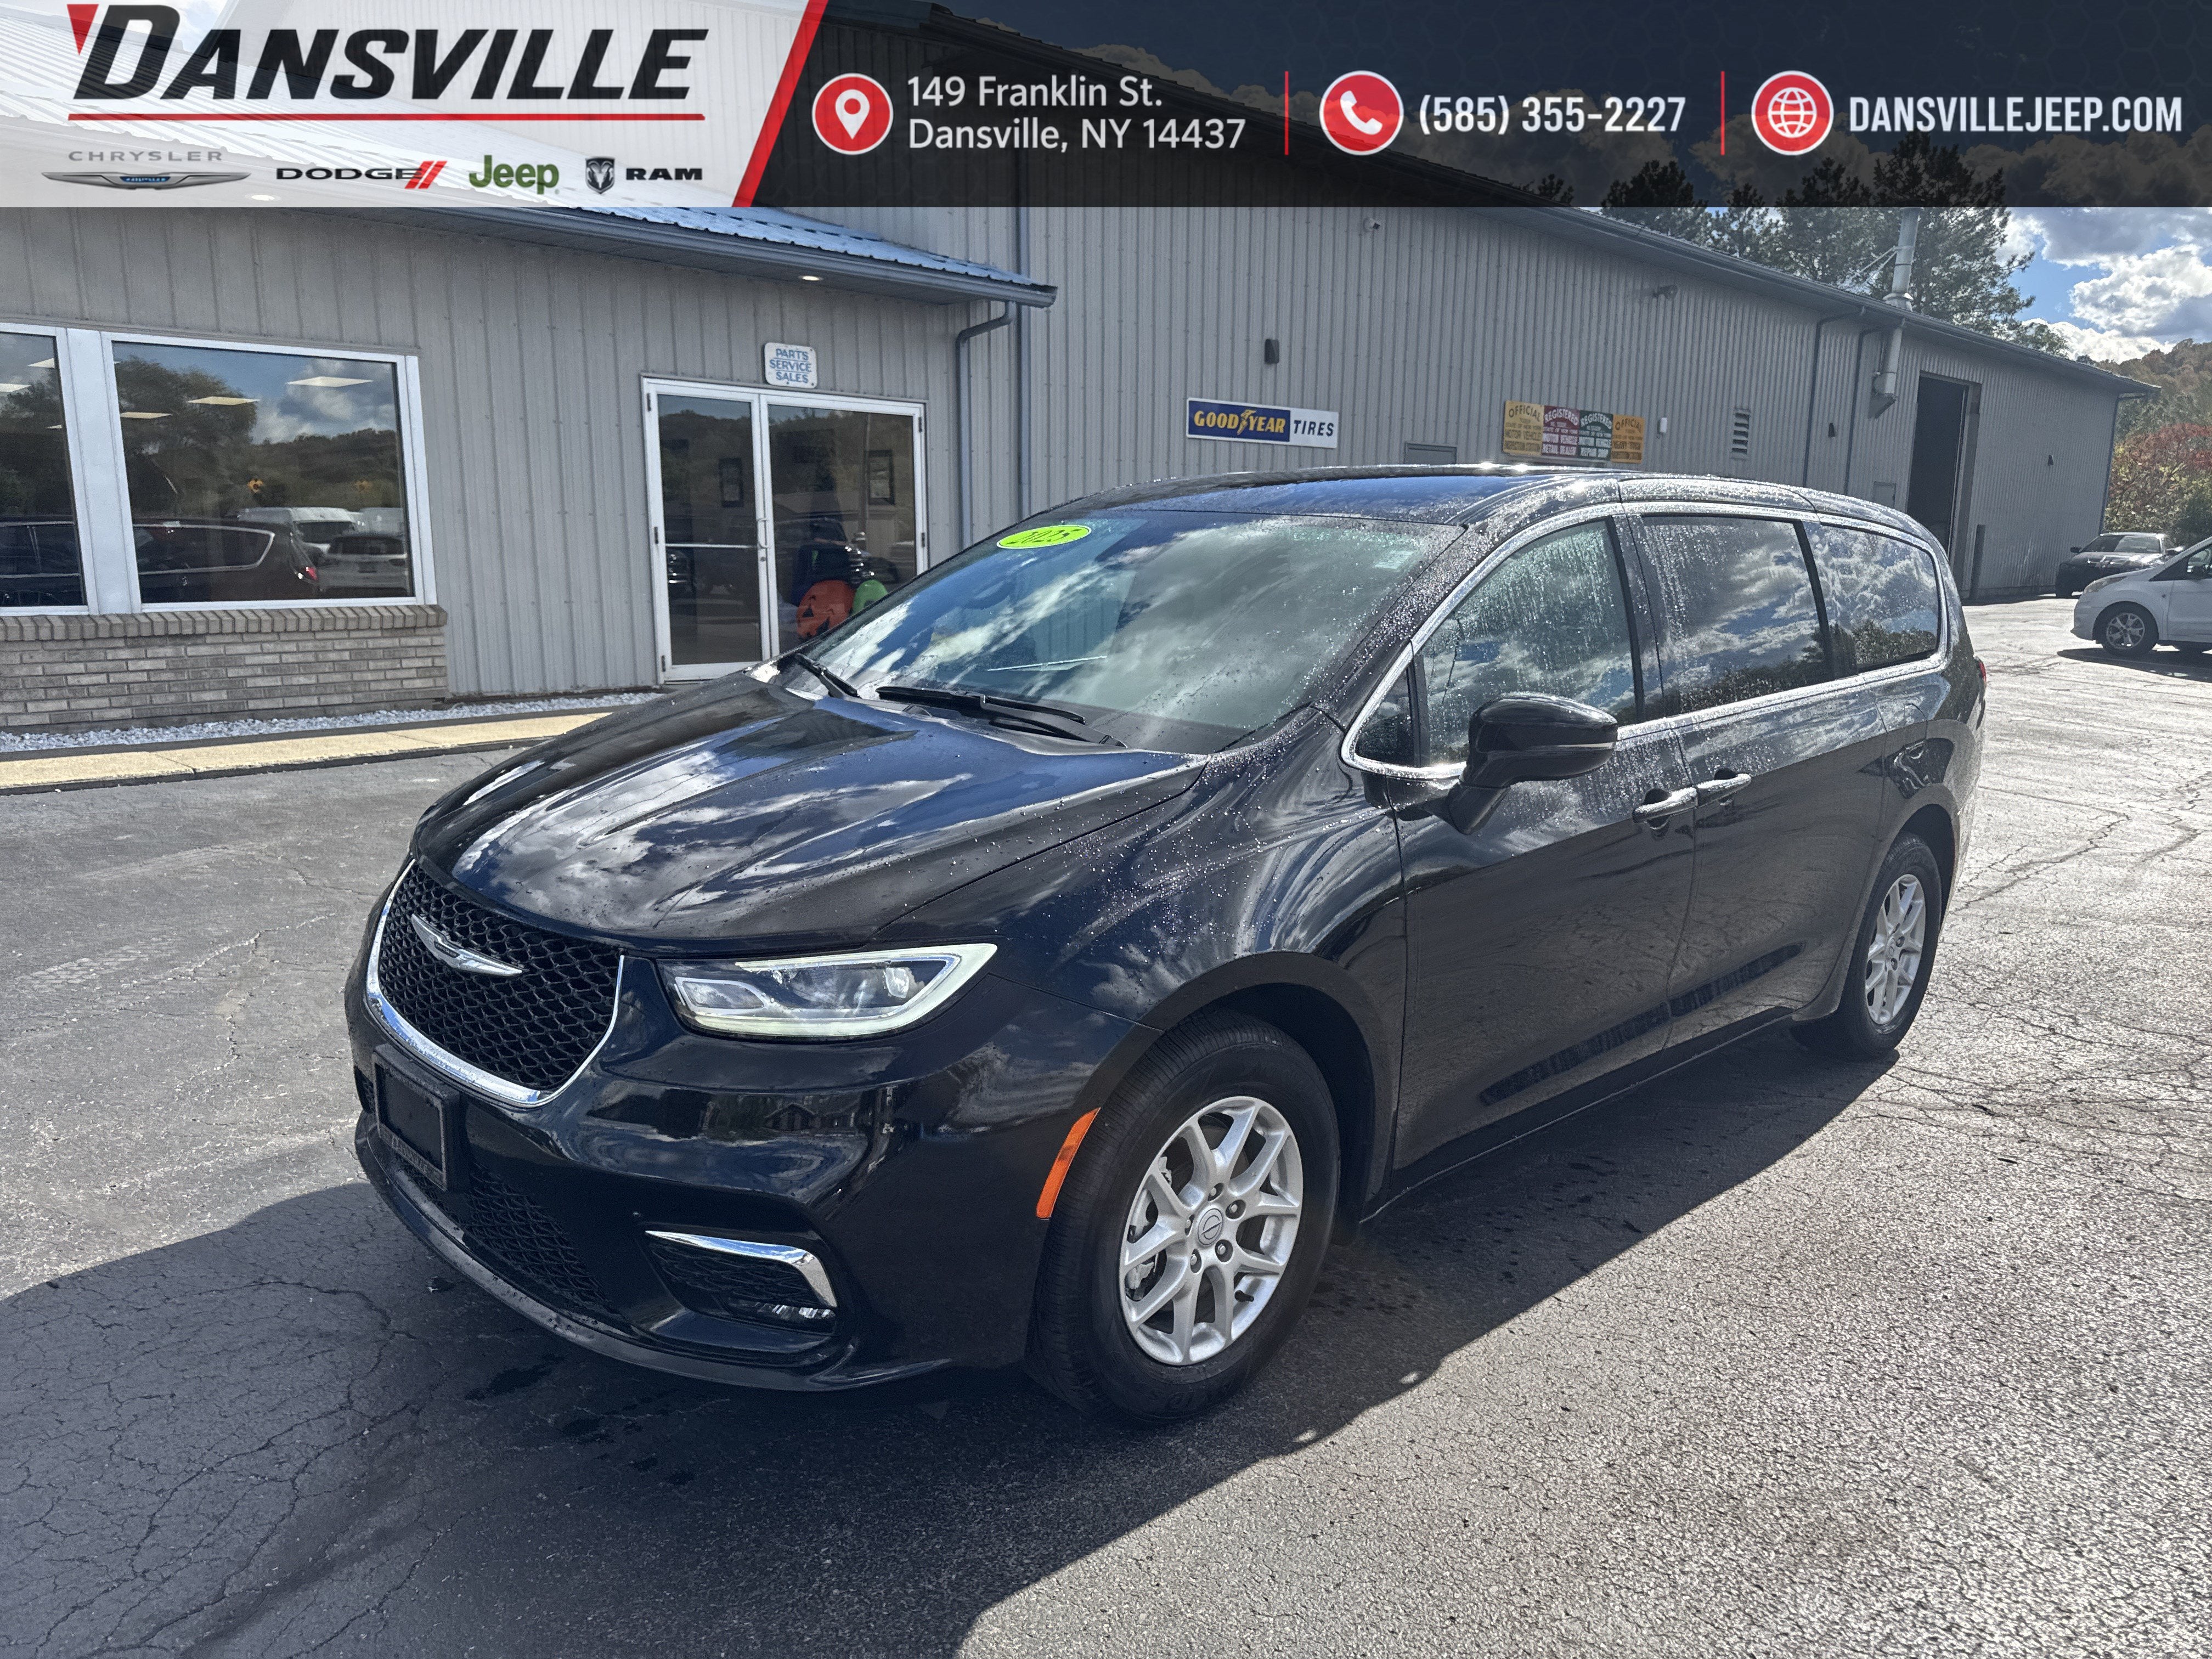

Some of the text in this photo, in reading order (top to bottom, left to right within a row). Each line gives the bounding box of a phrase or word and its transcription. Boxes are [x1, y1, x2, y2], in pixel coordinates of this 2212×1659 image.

[776, 348, 809, 360] PARTS
[770, 359, 811, 372] SERVICE
[776, 371, 809, 383] SALES
[1509, 405, 1541, 422] OFFICIAL
[1544, 408, 1578, 426] REGISTERED
[1194, 409, 1334, 437] GOODYEAR TIRES
[1581, 413, 1612, 430] REGISTERED
[1615, 418, 1641, 433] OFFICIAL
[1505, 429, 1521, 439] MOTOR
